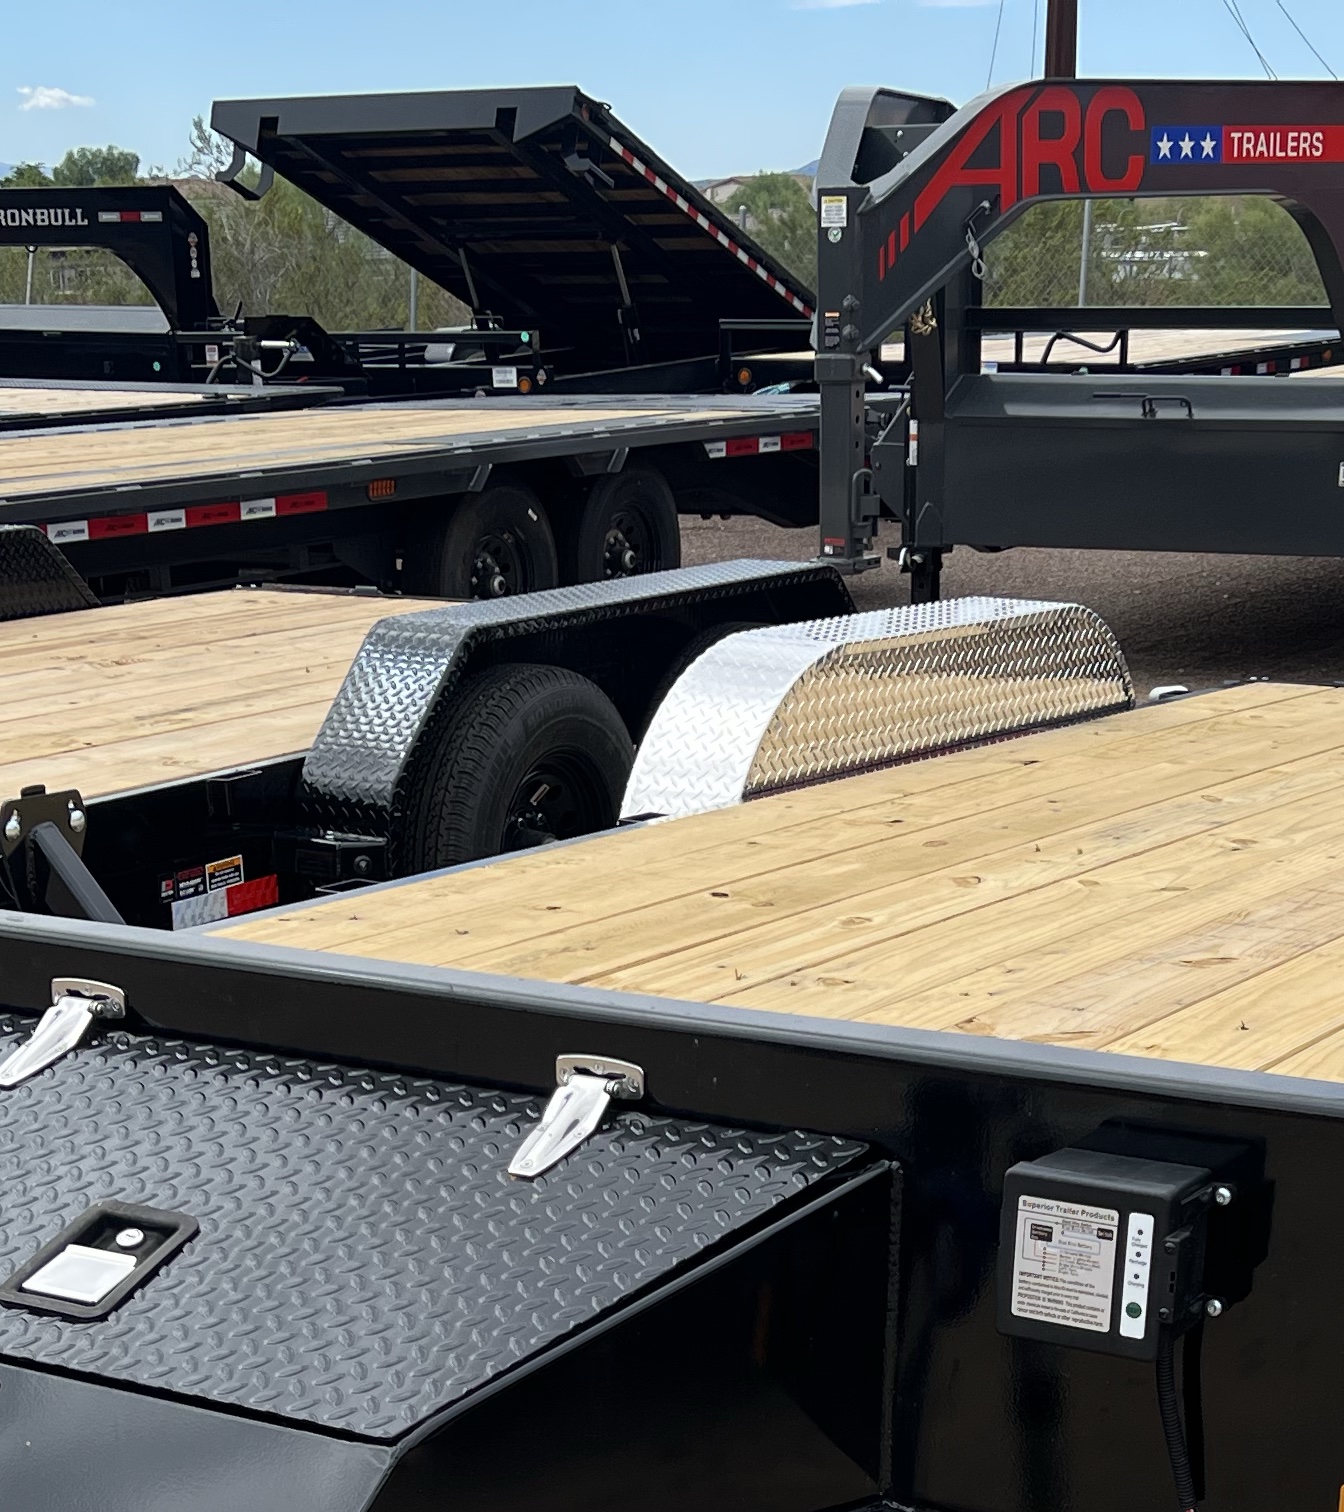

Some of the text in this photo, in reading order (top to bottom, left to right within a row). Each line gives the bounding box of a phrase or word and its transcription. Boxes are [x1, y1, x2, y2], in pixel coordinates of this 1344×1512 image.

[914, 85, 1324, 234] ARC TRAILERS
[1055, 1204, 1080, 1216] Trailer
[1080, 1209, 1115, 1222] Products
